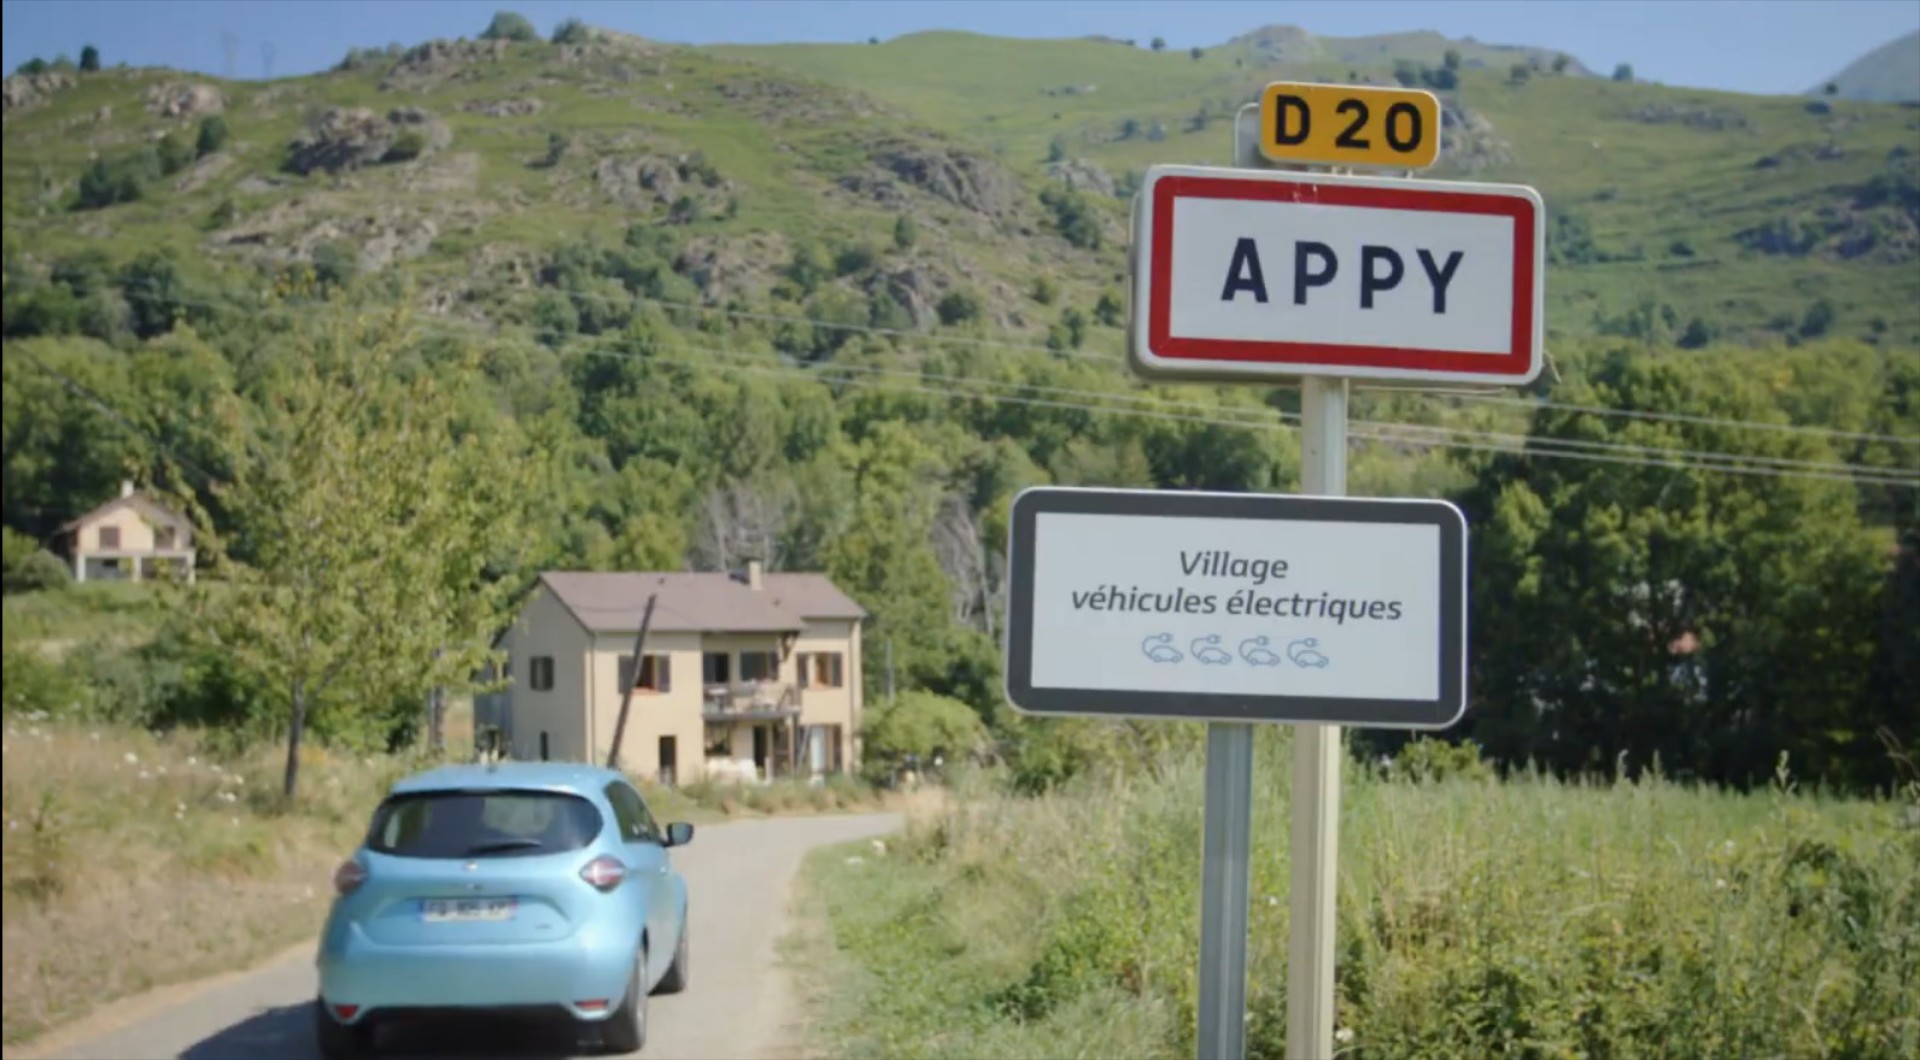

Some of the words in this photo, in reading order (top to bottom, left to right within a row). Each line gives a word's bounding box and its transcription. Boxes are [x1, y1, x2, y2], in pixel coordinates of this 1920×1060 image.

[1274, 94, 1311, 145] D
[1335, 98, 1422, 153] 20
[1220, 237, 1464, 314] APPY
[1179, 550, 1289, 585] Village
[1071, 585, 1218, 615] véhicules
[1226, 588, 1403, 625] électriques
